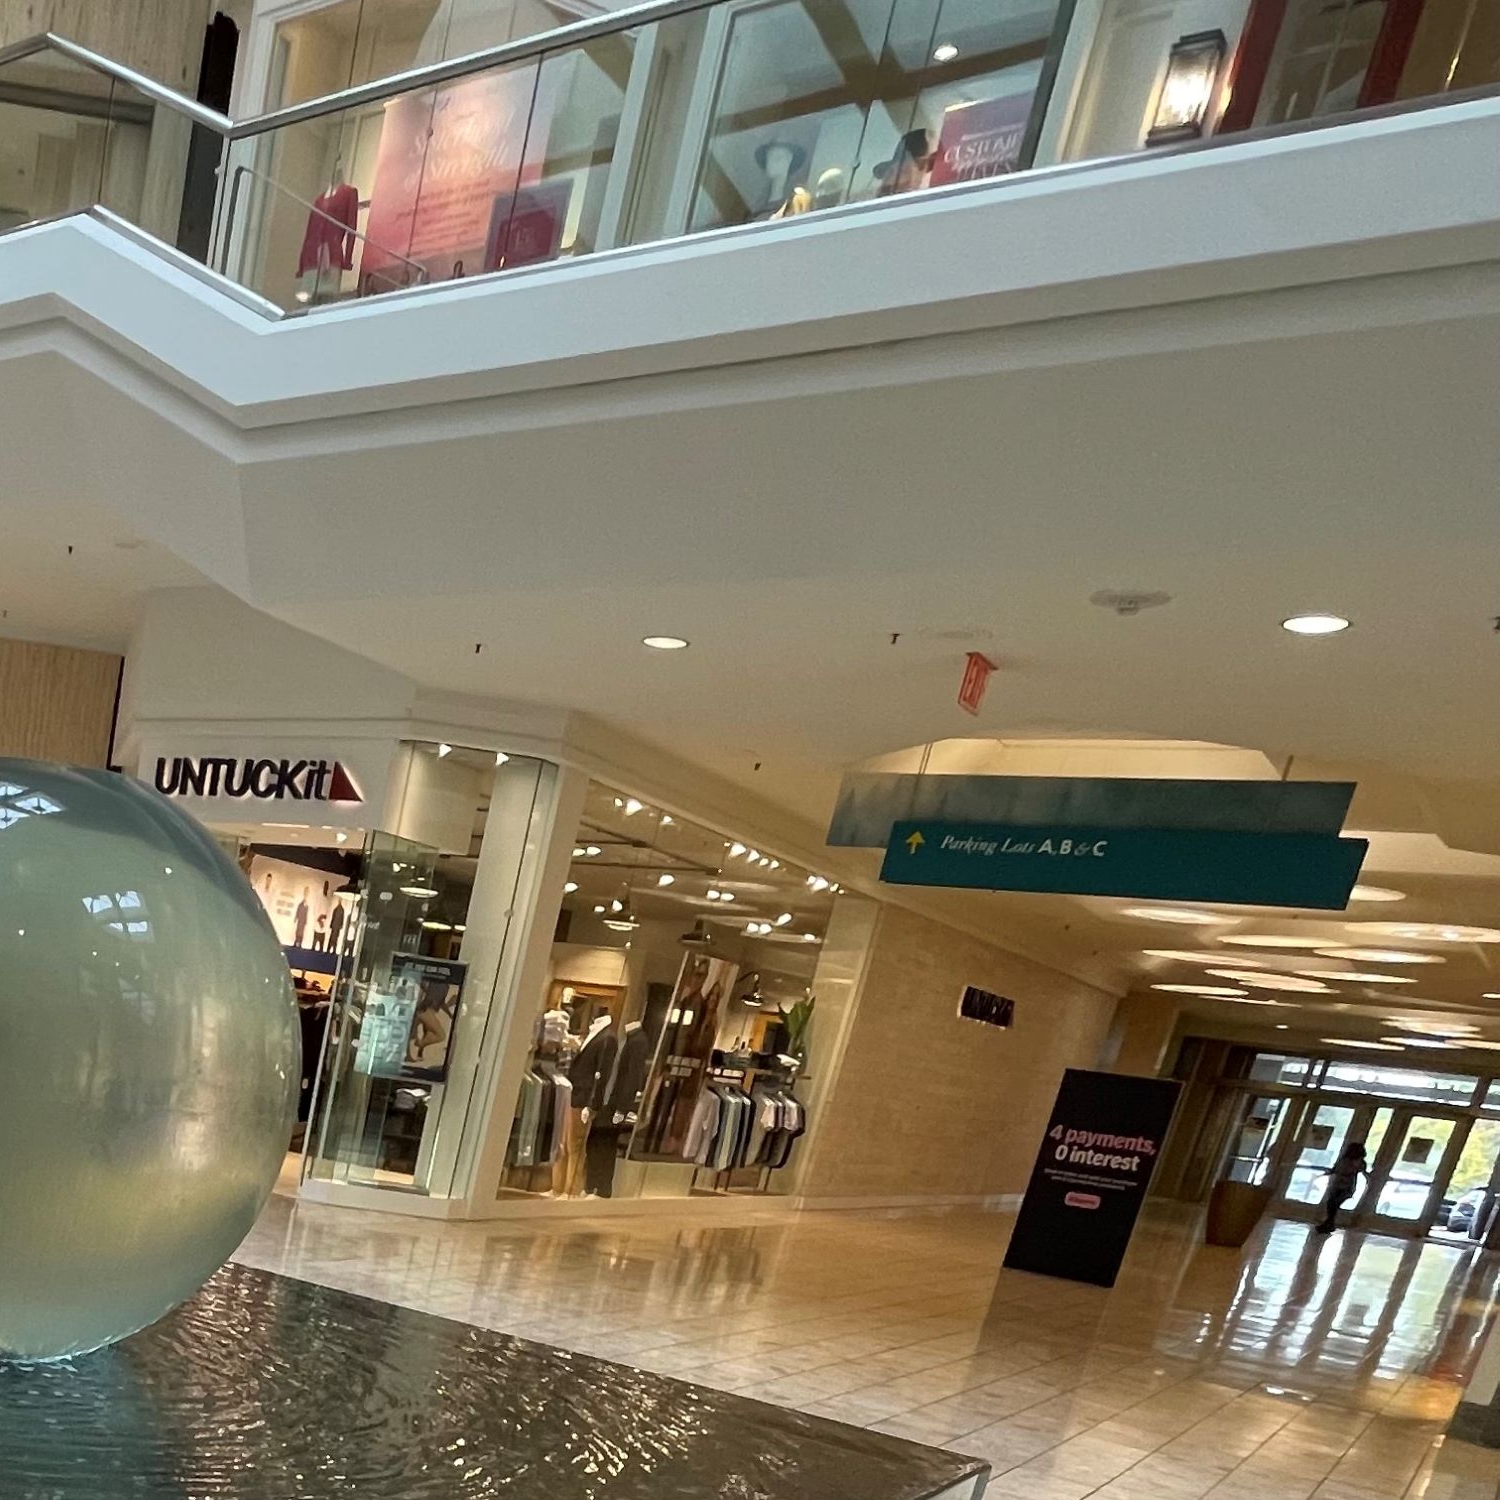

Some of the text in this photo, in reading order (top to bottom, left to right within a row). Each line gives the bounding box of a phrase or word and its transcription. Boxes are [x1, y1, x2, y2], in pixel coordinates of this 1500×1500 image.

[154, 756, 332, 801] UNTUCKit
[940, 835, 999, 856] Parking
[1001, 837, 1036, 853] Lots
[1074, 842, 1092, 857] &
[1092, 840, 1108, 857] C
[1049, 1124, 1157, 1156] 4 payments,
[1055, 1144, 1140, 1171] 0 interest
